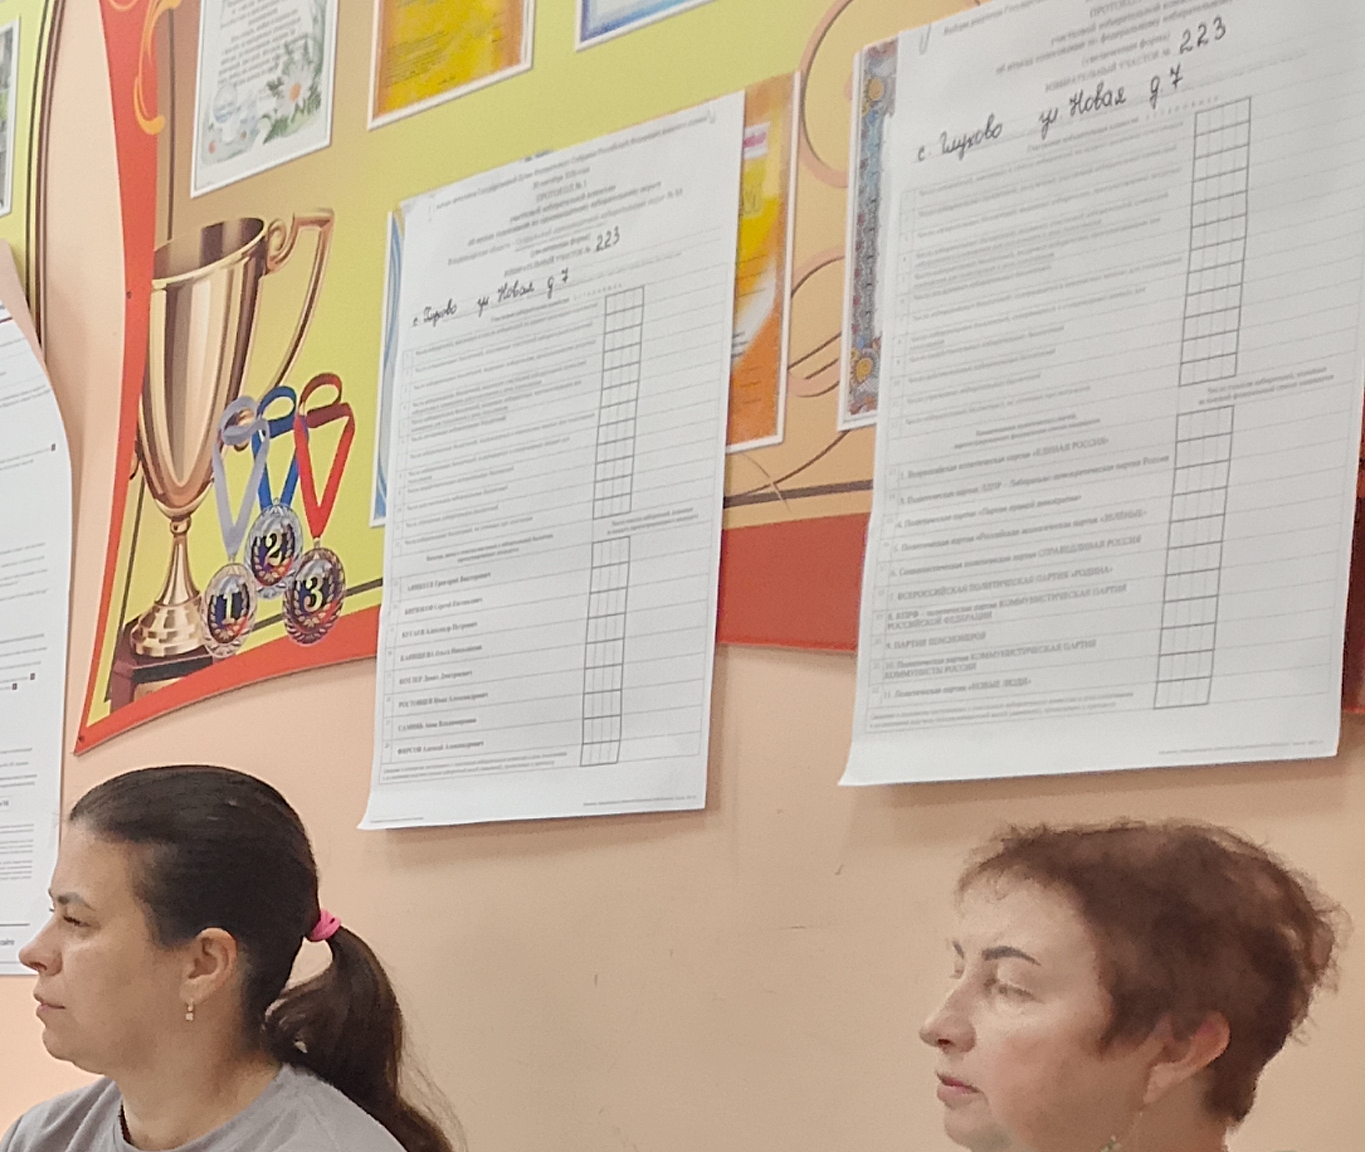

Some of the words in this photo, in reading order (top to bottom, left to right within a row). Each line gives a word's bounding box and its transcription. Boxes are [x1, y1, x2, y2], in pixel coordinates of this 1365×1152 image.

[1179, 15, 1226, 56] 223
[1070, 81, 1127, 117] Новая
[1170, 64, 1183, 89] 7
[595, 226, 621, 253] 223
[264, 532, 283, 565] 2
[303, 576, 323, 612] 3
